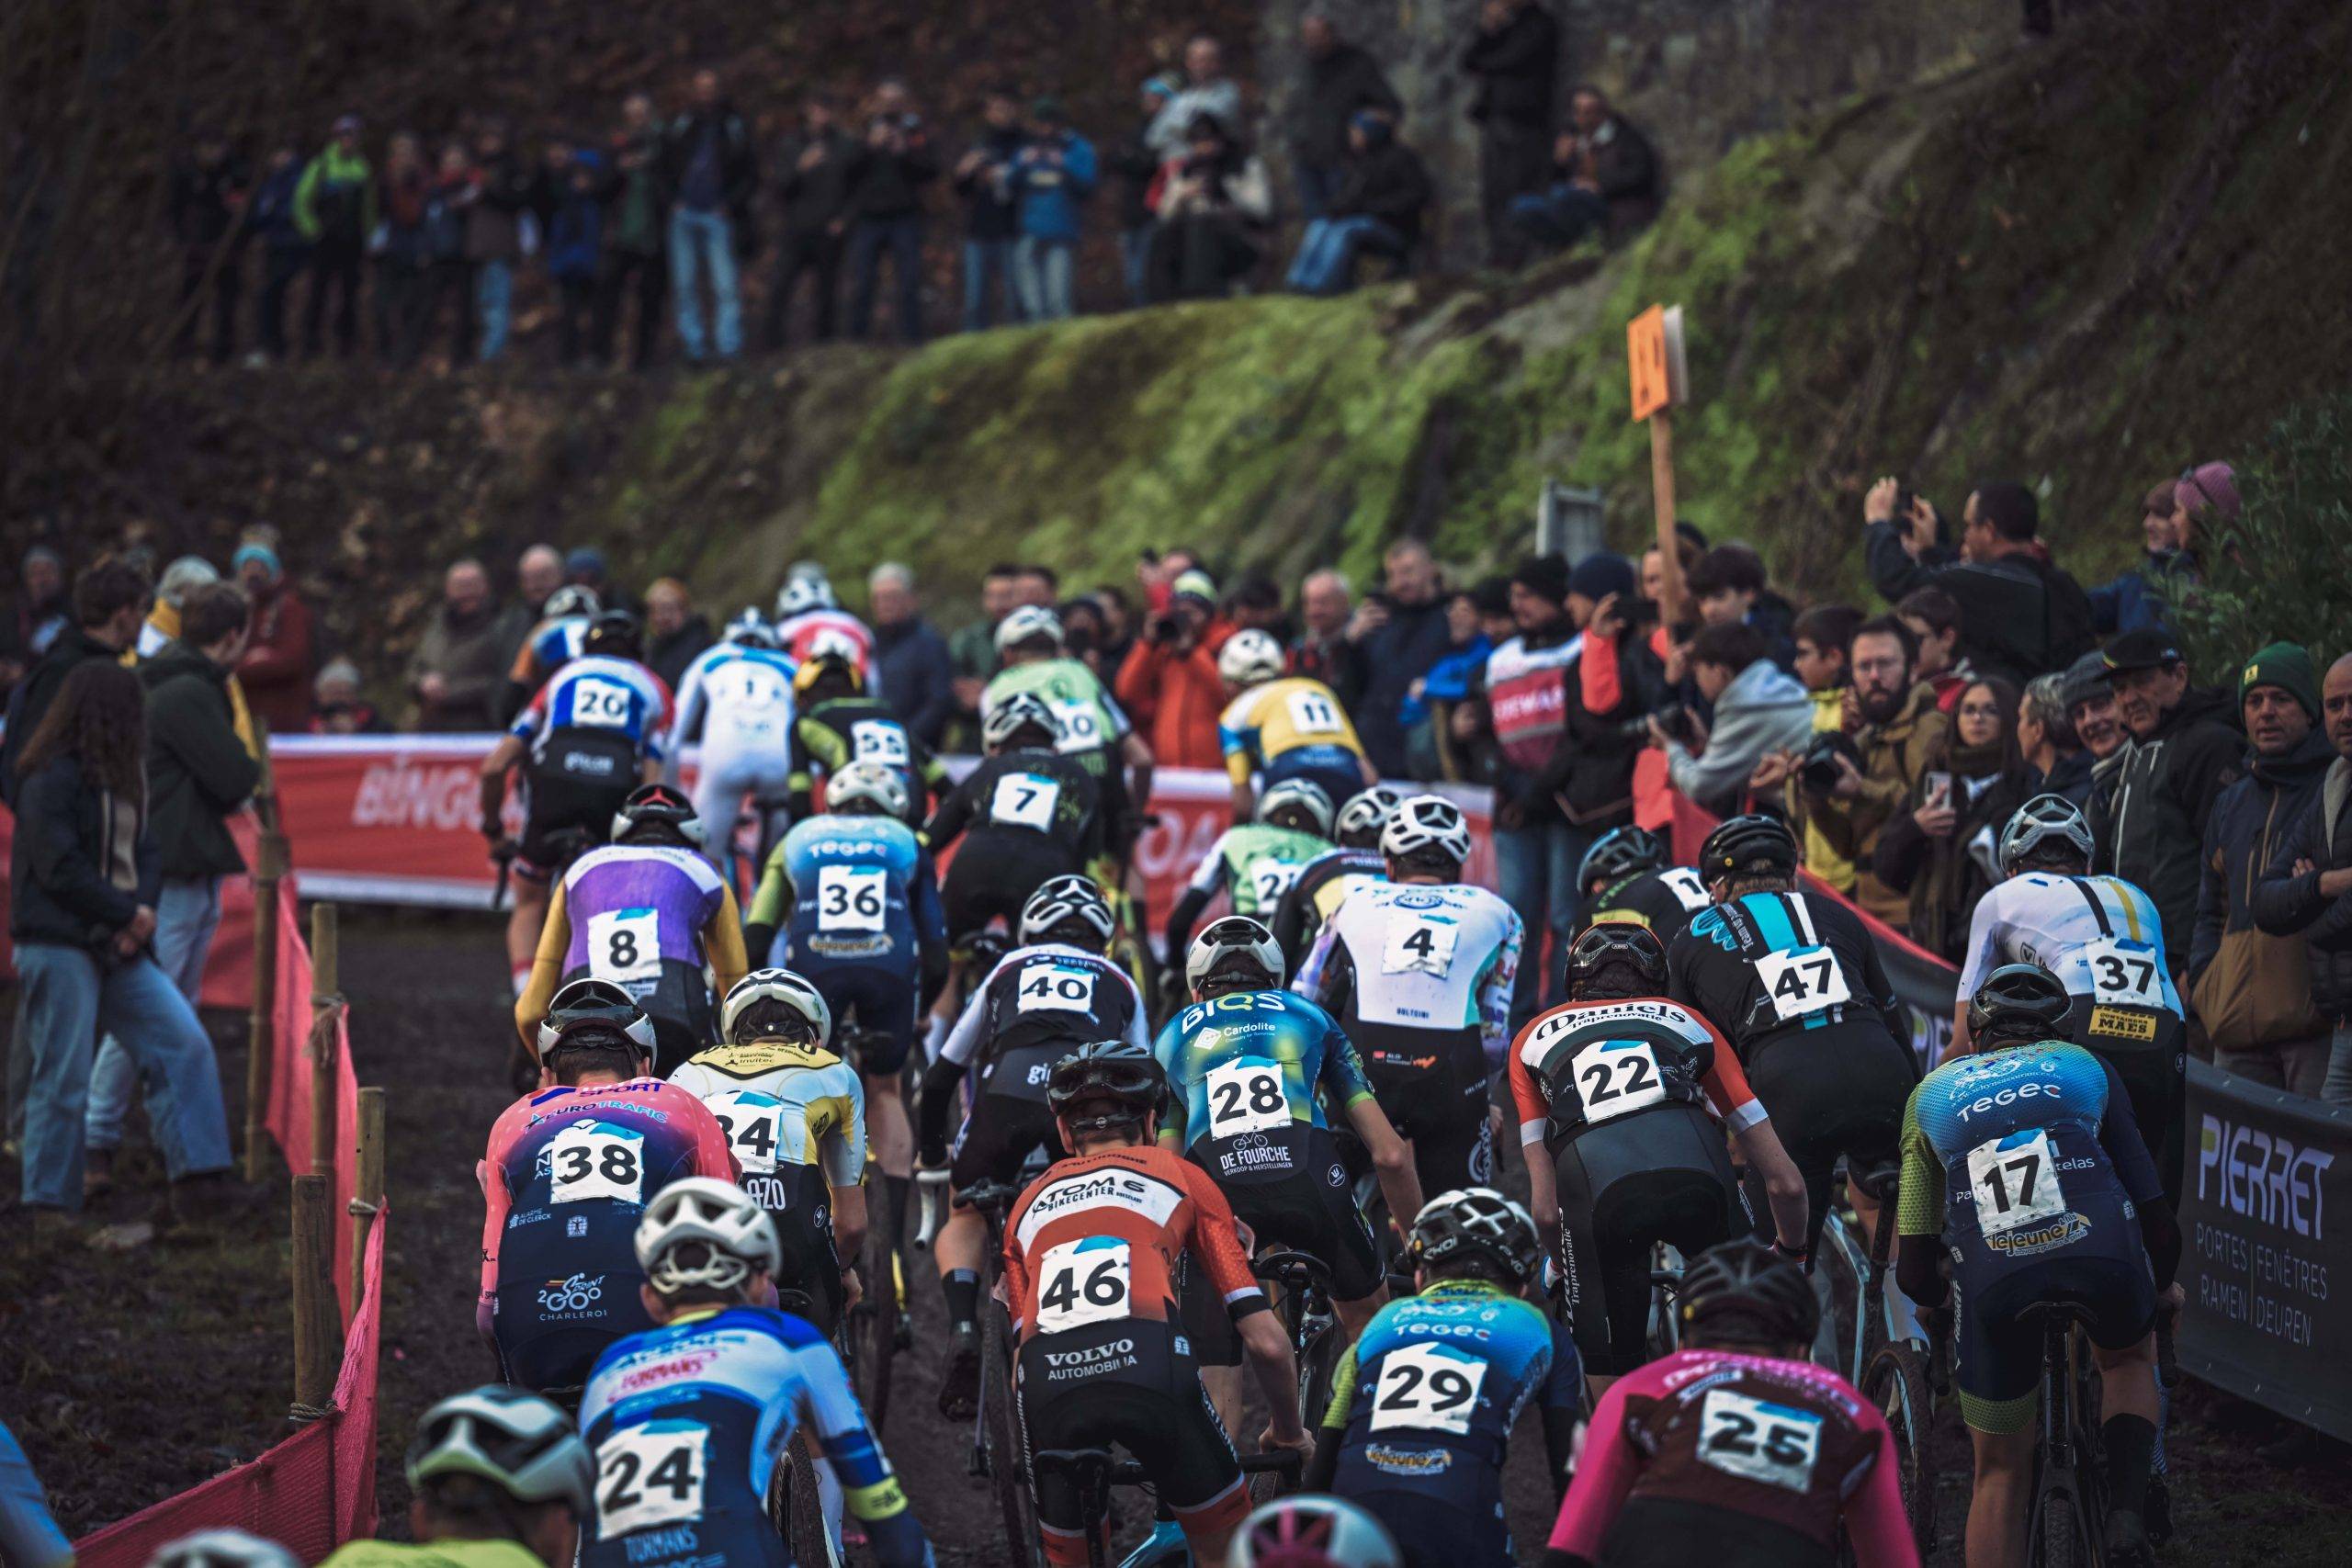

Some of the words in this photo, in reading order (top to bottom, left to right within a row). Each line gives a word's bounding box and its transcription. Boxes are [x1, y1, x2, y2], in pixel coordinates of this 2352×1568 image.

[580, 691, 625, 716] 20
[1304, 703, 1330, 722] 11
[1016, 787, 1037, 812] 7
[824, 883, 881, 917] 36
[609, 930, 639, 968] 8
[1402, 928, 1435, 958] 4
[1022, 976, 1089, 999] 40
[1773, 957, 1833, 1000] 47
[2095, 955, 2155, 995] 37
[1223, 1021, 1276, 1037] Cardolite
[1536, 1003, 1687, 1041] Daniels
[1571, 1010, 1663, 1029] Traprenovatie
[2098, 1018, 2148, 1034] MAES
[579, 1082, 666, 1098] SPORT
[1580, 1055, 1659, 1107] 22
[546, 1100, 669, 1123] EUROTRAFIC
[1212, 1074, 1284, 1124] 28
[557, 1144, 639, 1185] 38
[1220, 1153, 1236, 1170] DE
[1238, 1146, 1291, 1167] FOURCHE
[1224, 1167, 1248, 1177] VERKOOP
[1123, 1179, 1146, 1193] 6
[1984, 1154, 2041, 1214] 17
[2198, 1113, 2335, 1241] PIERRET
[1047, 1186, 1115, 1212] BIKECENTER
[2197, 1222, 2248, 1273] PORTES
[1564, 1228, 1580, 1305] Traprenovatie
[1041, 1258, 1125, 1314] 46
[539, 1309, 607, 1321] CHARLEROI
[2201, 1275, 2247, 1322] RAMEN
[2256, 1297, 2312, 1347] DEUREN
[1045, 1338, 1134, 1366] VOLVO
[1378, 1364, 1473, 1412] 29
[1709, 1411, 1810, 1465] 25
[603, 1447, 698, 1516] 24
